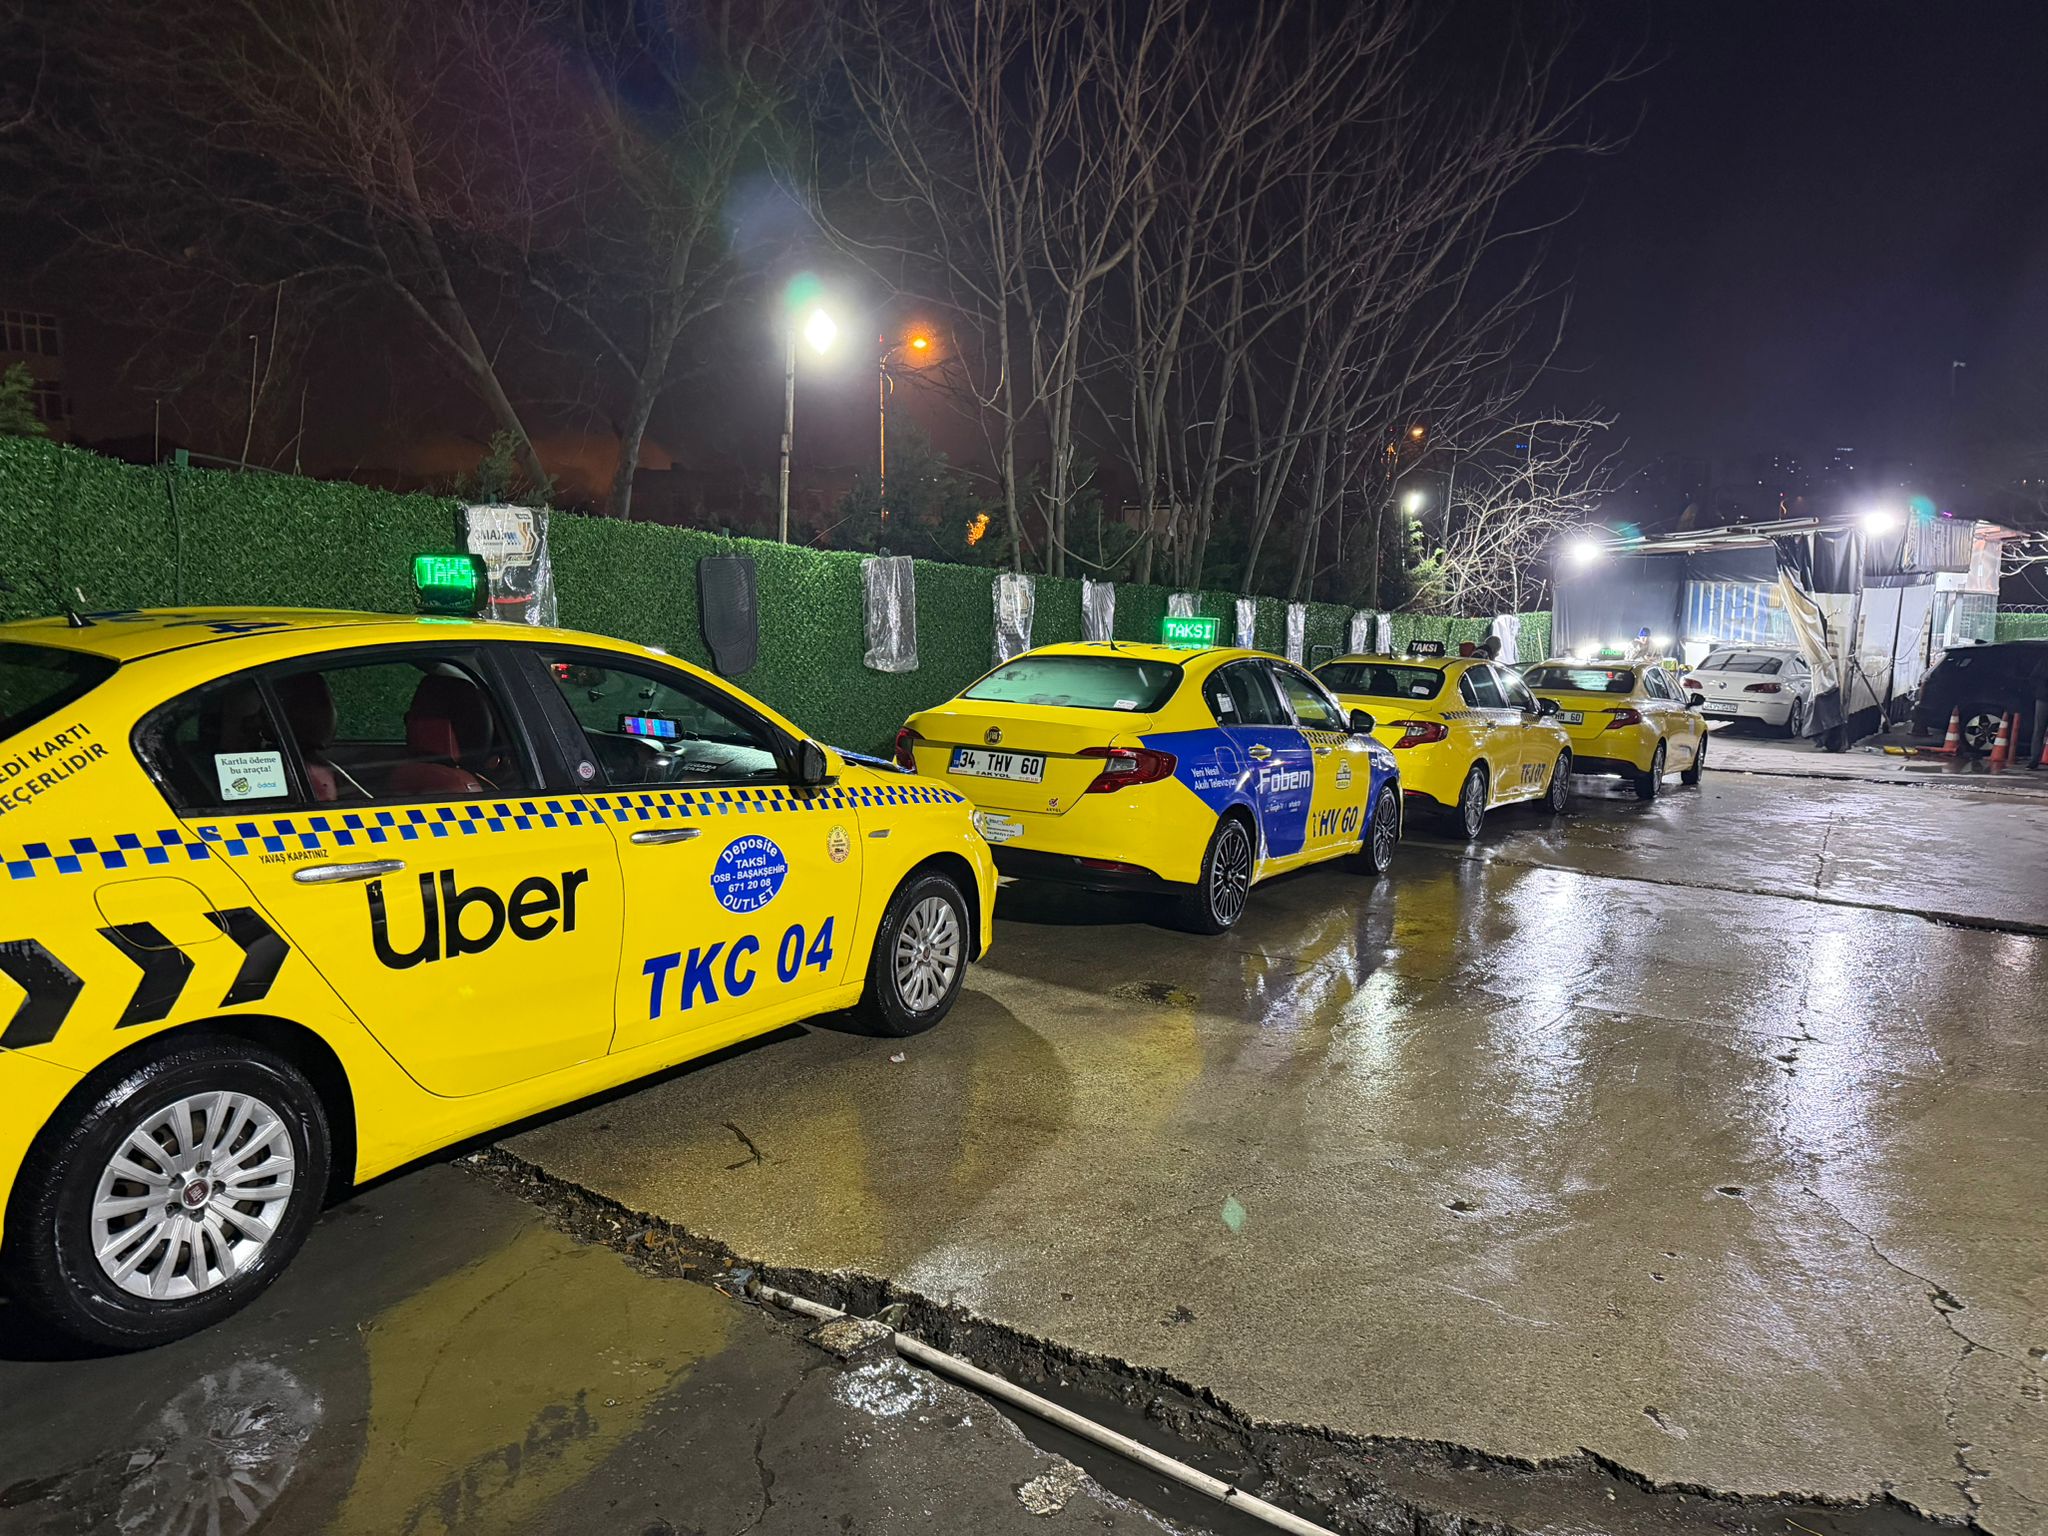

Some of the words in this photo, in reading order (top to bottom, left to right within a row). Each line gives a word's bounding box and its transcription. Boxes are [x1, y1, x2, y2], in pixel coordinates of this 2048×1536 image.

[27, 722, 91, 763] KARTI
[220, 757, 248, 766] Kartla
[249, 756, 277, 764] ödeme
[229, 767, 242, 775] bu
[242, 765, 272, 775] araçta!
[960, 751, 975, 769] 34
[988, 753, 1013, 773] THV
[1020, 757, 1040, 776] 60
[1190, 767, 1205, 778] Yeni
[1205, 765, 1220, 776] Nesil
[0, 742, 109, 816] EÇERLİDİR
[980, 770, 1011, 779] AKYOL
[1208, 777, 1238, 789] Televizyon
[1258, 766, 1311, 794] Fobem
[1341, 805, 1358, 833] 60
[258, 852, 286, 865] YAVAŞ
[286, 849, 329, 861] KAPATINIZ
[722, 838, 778, 864] Deposite
[735, 854, 767, 869] TAKSİ
[713, 873, 731, 883] OSB
[737, 863, 786, 880] BAŞAKŞEHİR
[728, 882, 745, 893] 671
[747, 880, 759, 890] 20
[760, 878, 772, 888] 08
[723, 886, 775, 911] OUTLET
[364, 867, 589, 970] Uber
[642, 934, 761, 1020] TKC
[777, 915, 835, 984] 04
